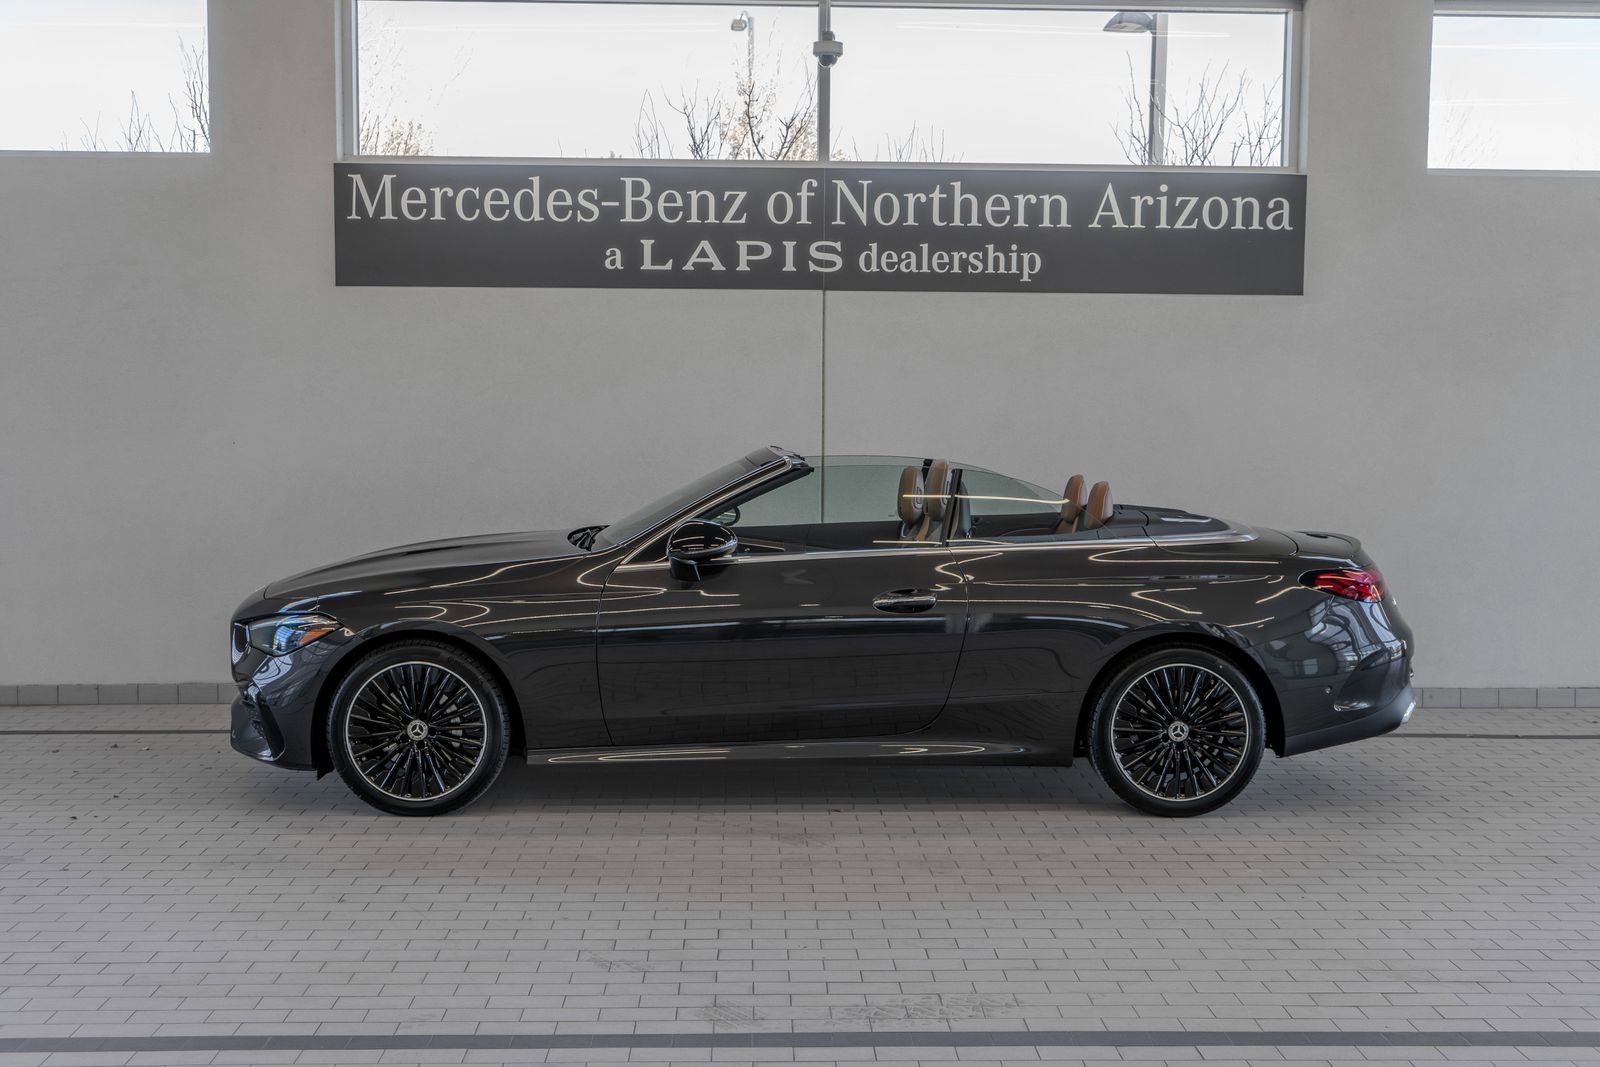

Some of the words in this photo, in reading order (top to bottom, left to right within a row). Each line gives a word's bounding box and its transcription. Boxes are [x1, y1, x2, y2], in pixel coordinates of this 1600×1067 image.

[346, 173, 747, 224] Mercedes-Benz
[766, 178, 818, 226] of
[830, 179, 1071, 228] Northern
[1088, 182, 1293, 232] Arizona
[604, 247, 624, 270] a
[639, 239, 843, 272] LAPIS
[858, 243, 1042, 282] dealership
